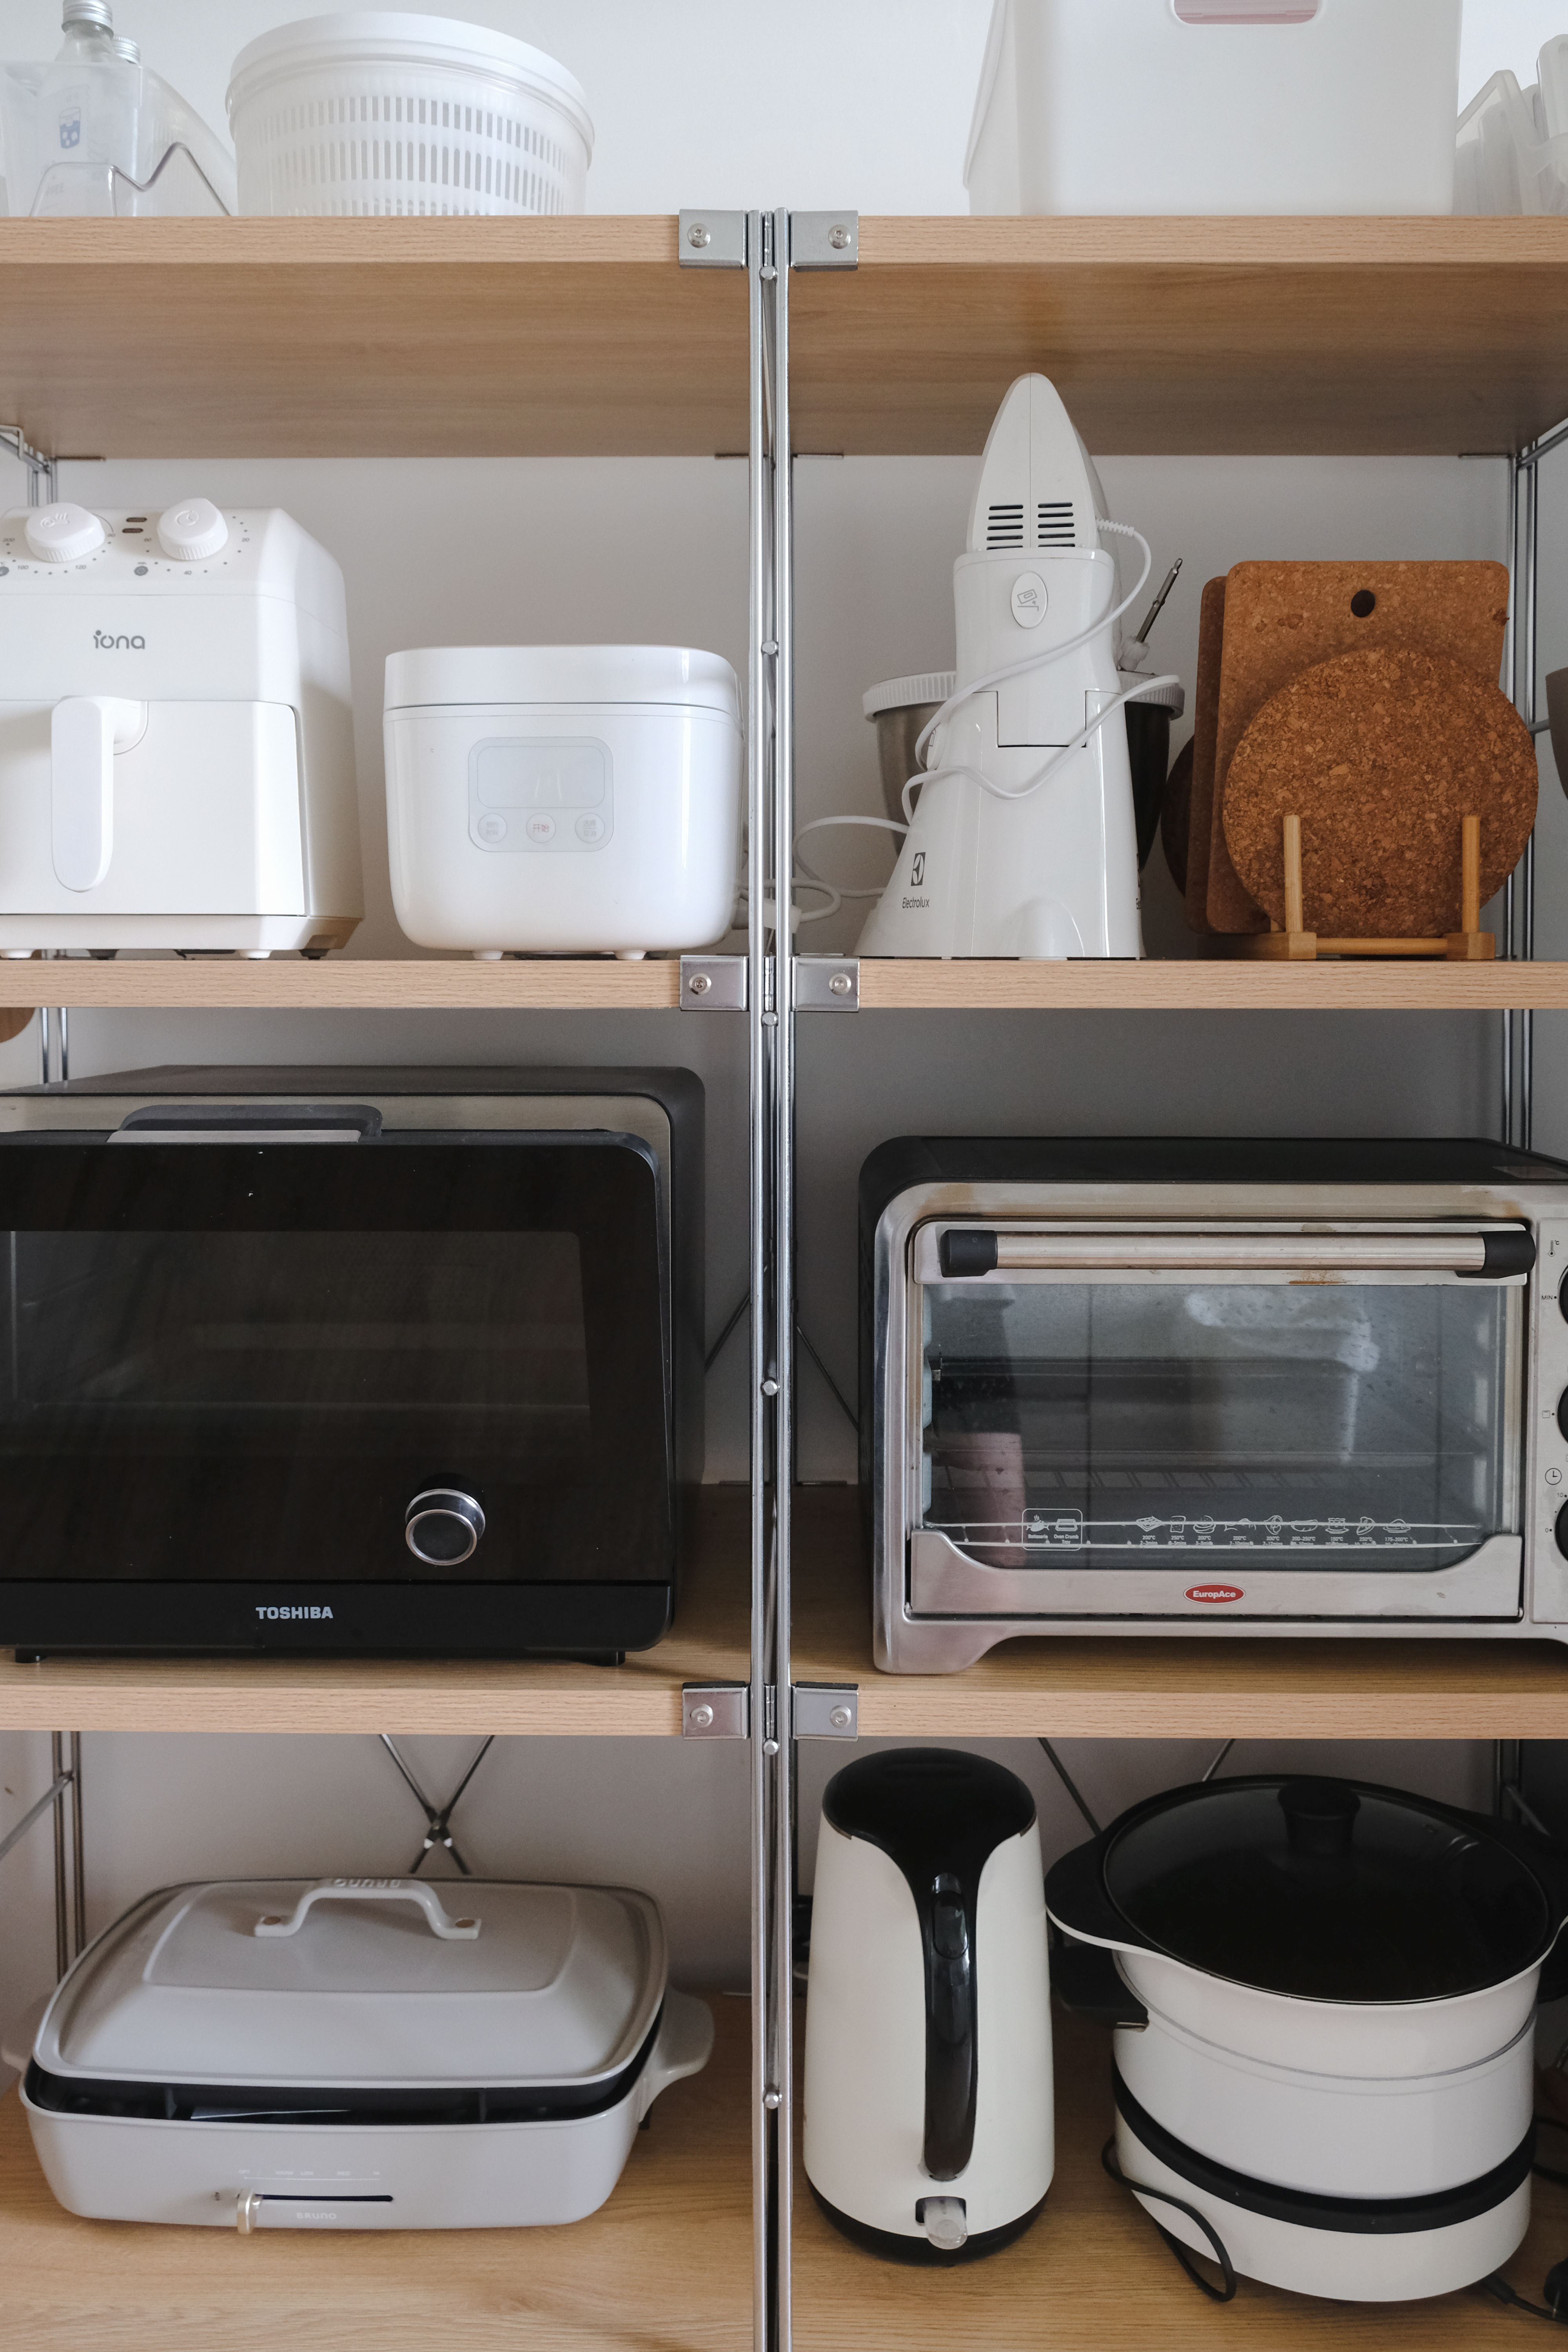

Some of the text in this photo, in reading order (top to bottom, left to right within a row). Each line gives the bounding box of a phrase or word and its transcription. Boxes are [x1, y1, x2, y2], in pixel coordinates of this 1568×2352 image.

[93, 630, 145, 650] iona
[532, 824, 549, 833] 开始
[902, 897, 929, 908] Electrolux
[1193, 1590, 1236, 1599] EuropAce
[255, 1606, 334, 1620] TOSHIBA
